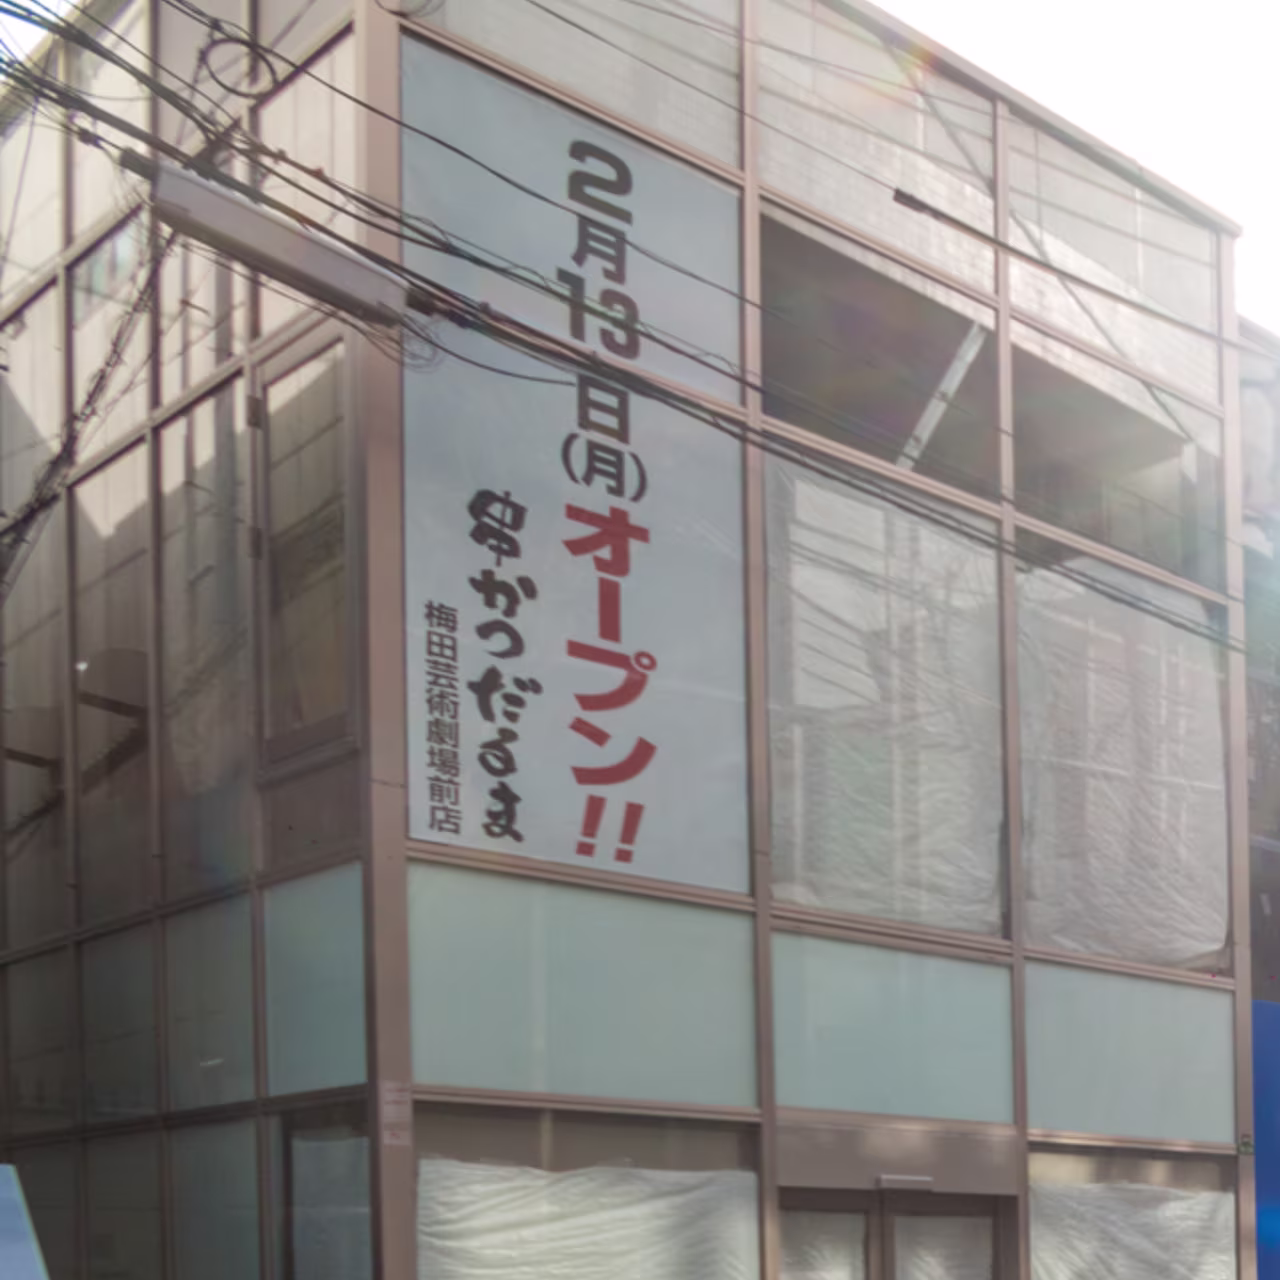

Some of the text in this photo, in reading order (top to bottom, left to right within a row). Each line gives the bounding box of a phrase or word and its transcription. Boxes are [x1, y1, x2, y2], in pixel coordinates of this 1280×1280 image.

[423, 599, 464, 837] 梅田芸術劇場前店
[466, 488, 544, 843] 串かつだるま
